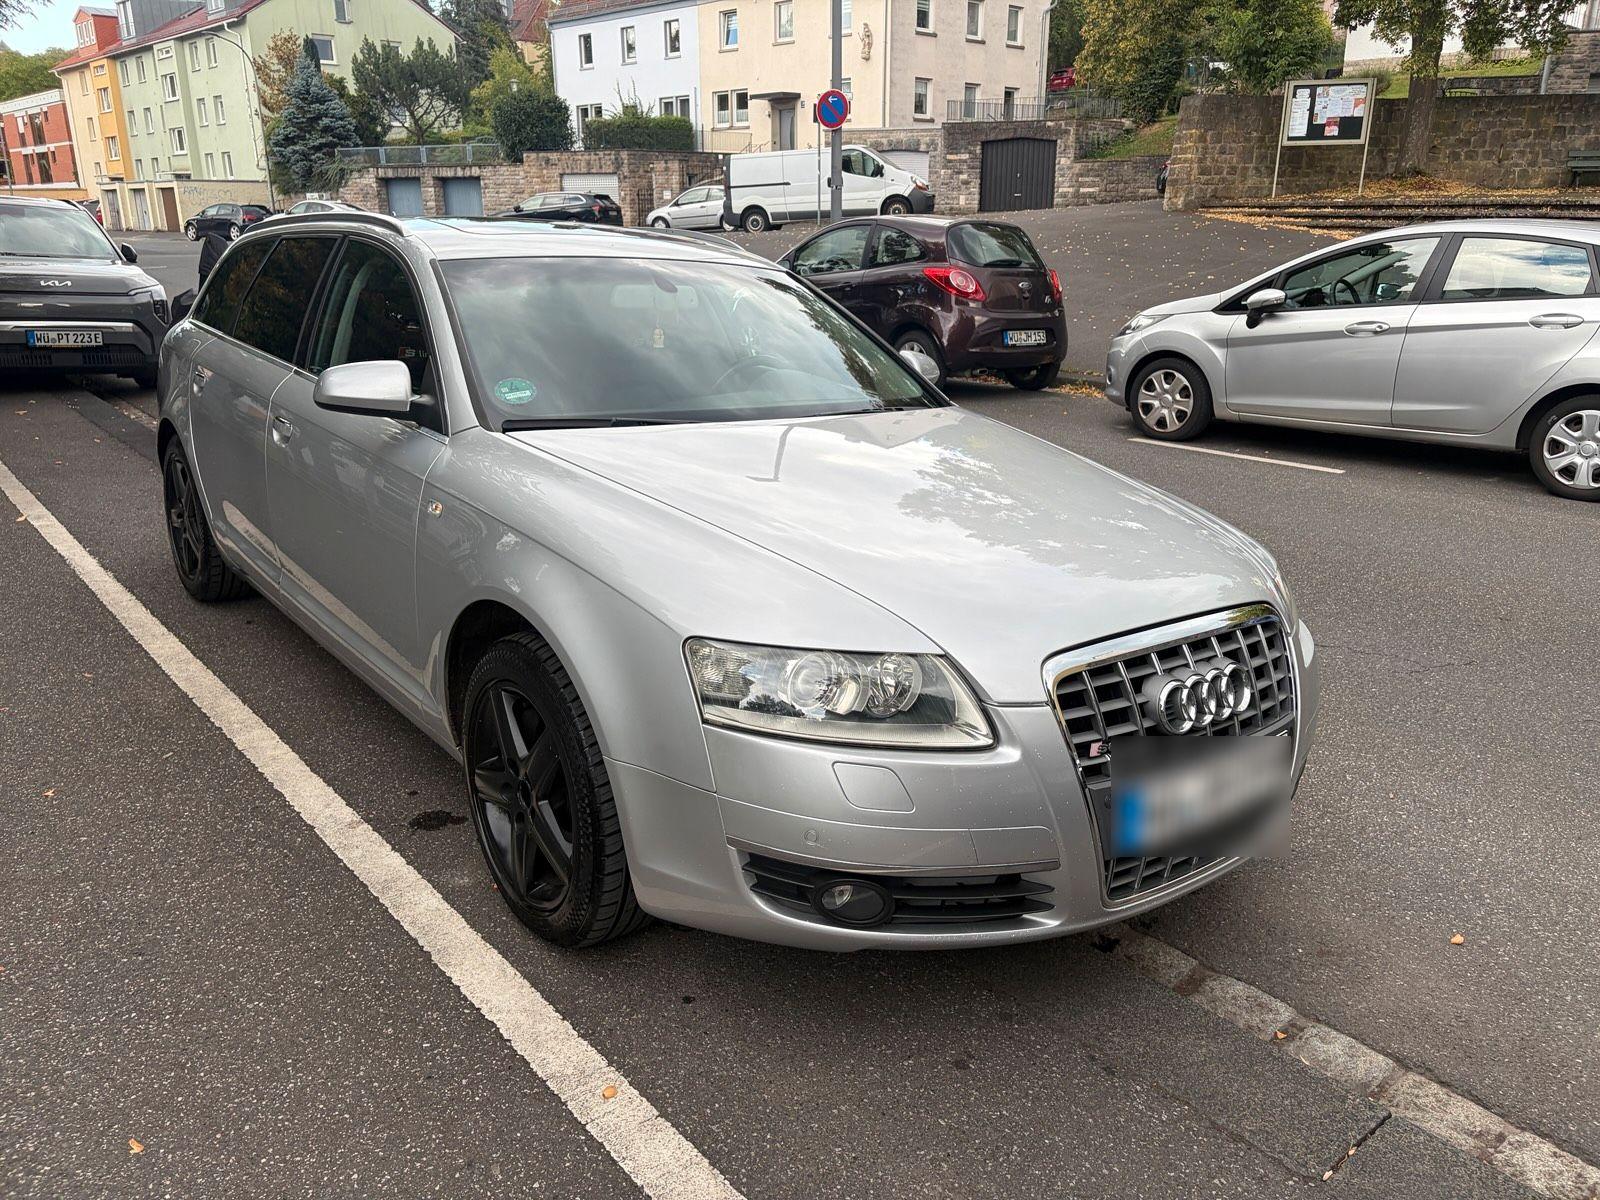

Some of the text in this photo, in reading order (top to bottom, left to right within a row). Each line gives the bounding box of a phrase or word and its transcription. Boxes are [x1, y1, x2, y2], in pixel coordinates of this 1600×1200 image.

[35, 333, 50, 344] WÜ
[57, 333, 70, 344] PT
[1023, 331, 1032, 343] JH
[1033, 331, 1045, 342] 153
